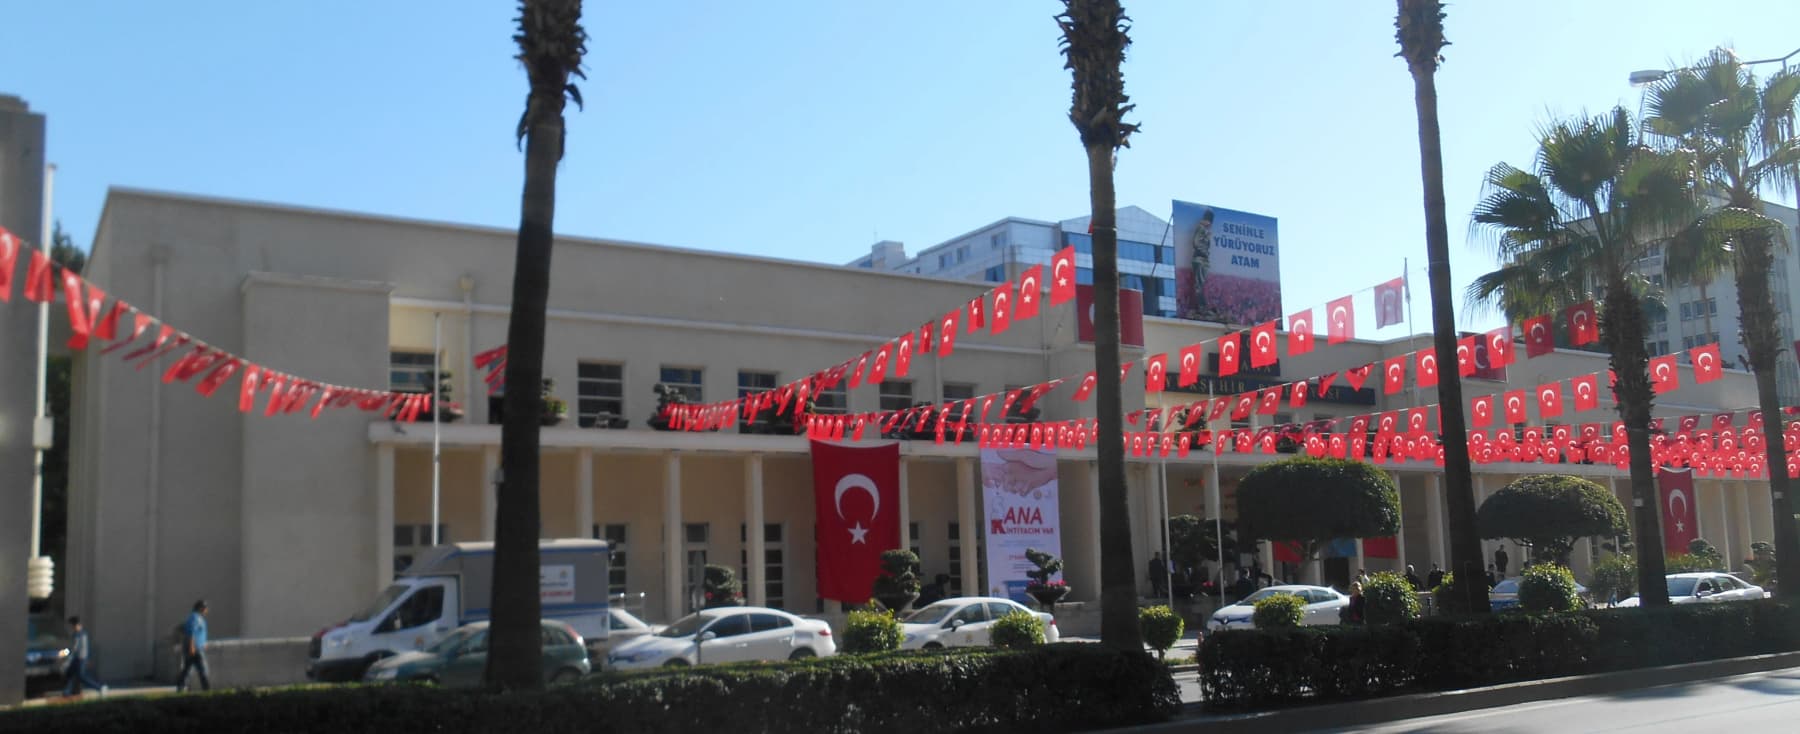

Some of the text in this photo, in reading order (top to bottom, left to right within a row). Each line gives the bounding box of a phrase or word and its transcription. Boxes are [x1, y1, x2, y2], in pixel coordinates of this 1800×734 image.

[1223, 222, 1264, 239] SENİNLE
[1214, 236, 1275, 256] YÜRÜYORUZ
[1231, 255, 1260, 268] ATAM
